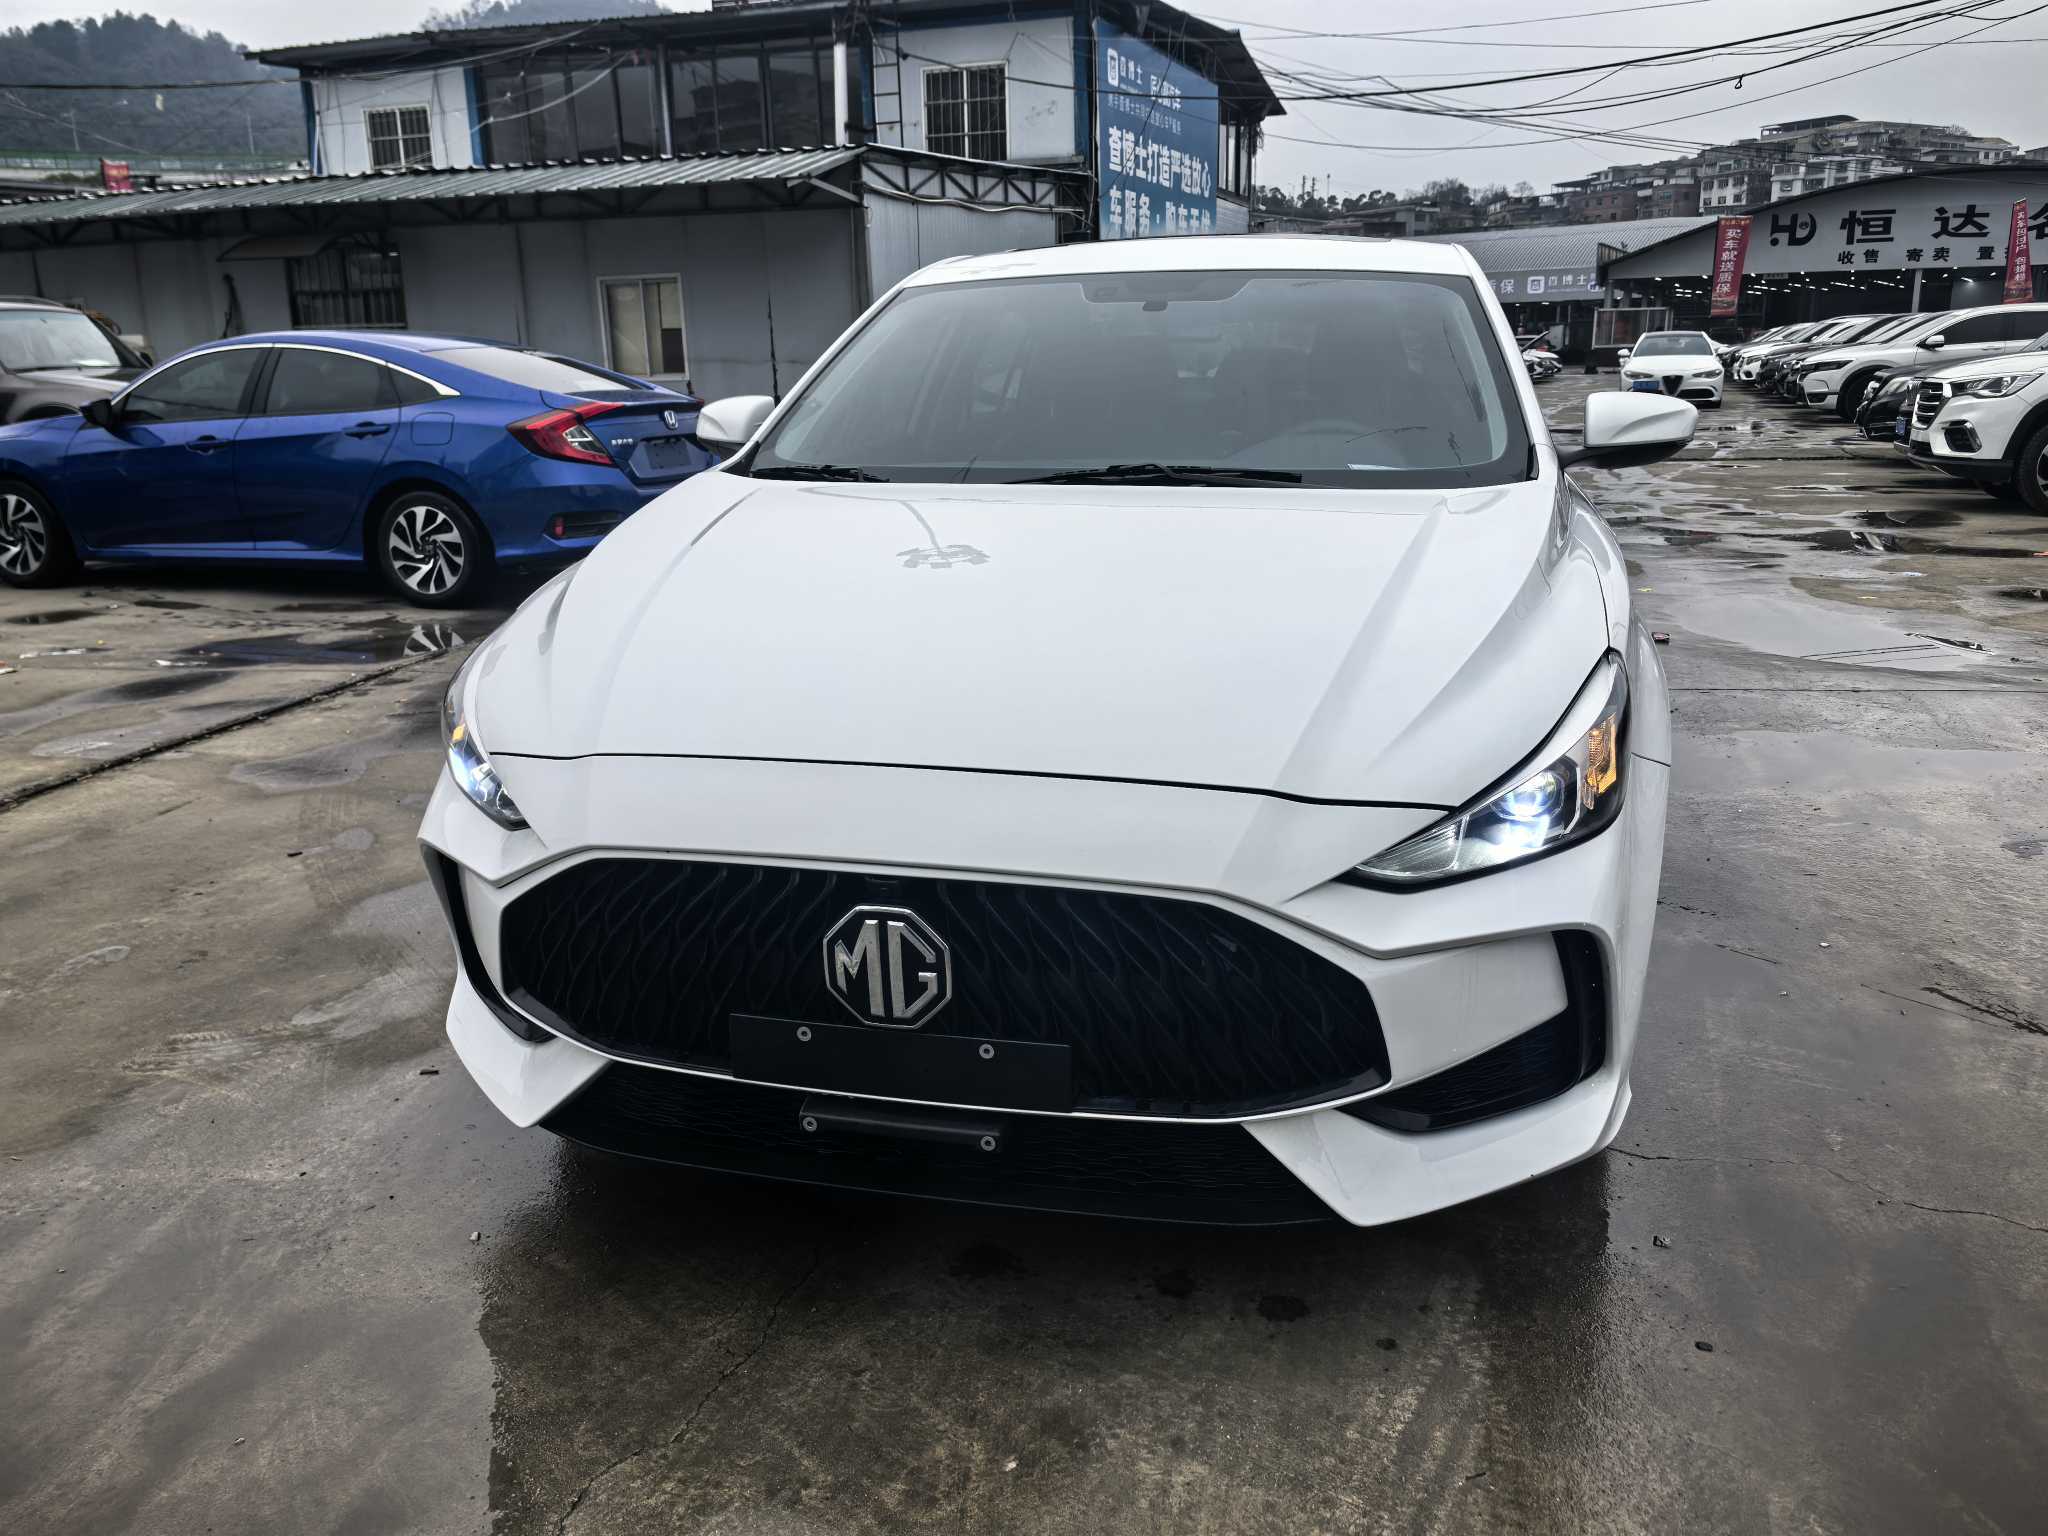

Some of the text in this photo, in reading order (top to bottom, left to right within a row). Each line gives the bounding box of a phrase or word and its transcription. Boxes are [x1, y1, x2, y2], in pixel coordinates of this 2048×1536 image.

[1108, 125, 1211, 198] 查博士打造严选放心
[1716, 228, 1742, 294] 买车就送质保
[1976, 245, 2008, 260] 置
[834, 919, 938, 1019] MG
